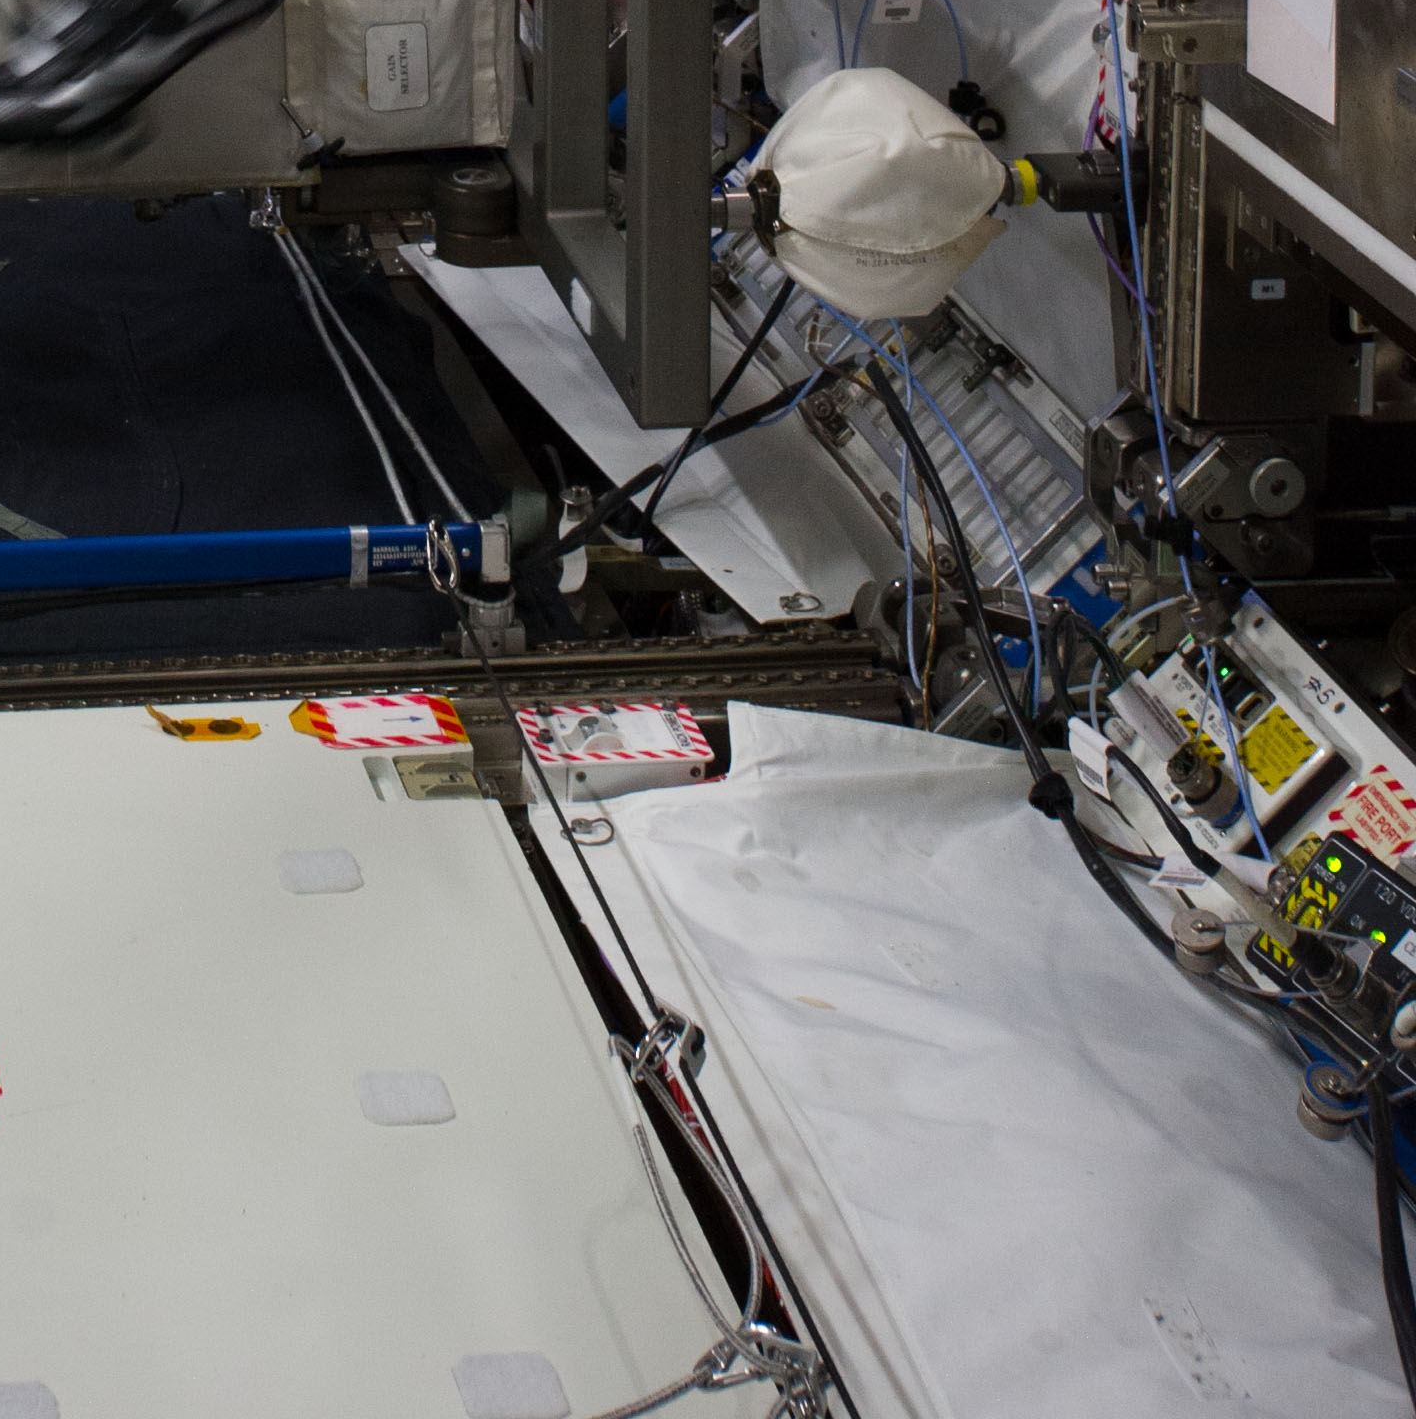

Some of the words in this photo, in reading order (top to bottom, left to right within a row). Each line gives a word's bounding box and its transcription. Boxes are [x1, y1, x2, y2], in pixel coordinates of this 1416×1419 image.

[387, 54, 397, 82] GAIN
[399, 38, 409, 95] SELECTOR
[1359, 795, 1380, 820] FIRE
[1376, 815, 1403, 845] PORT
[1375, 881, 1397, 906] 120
